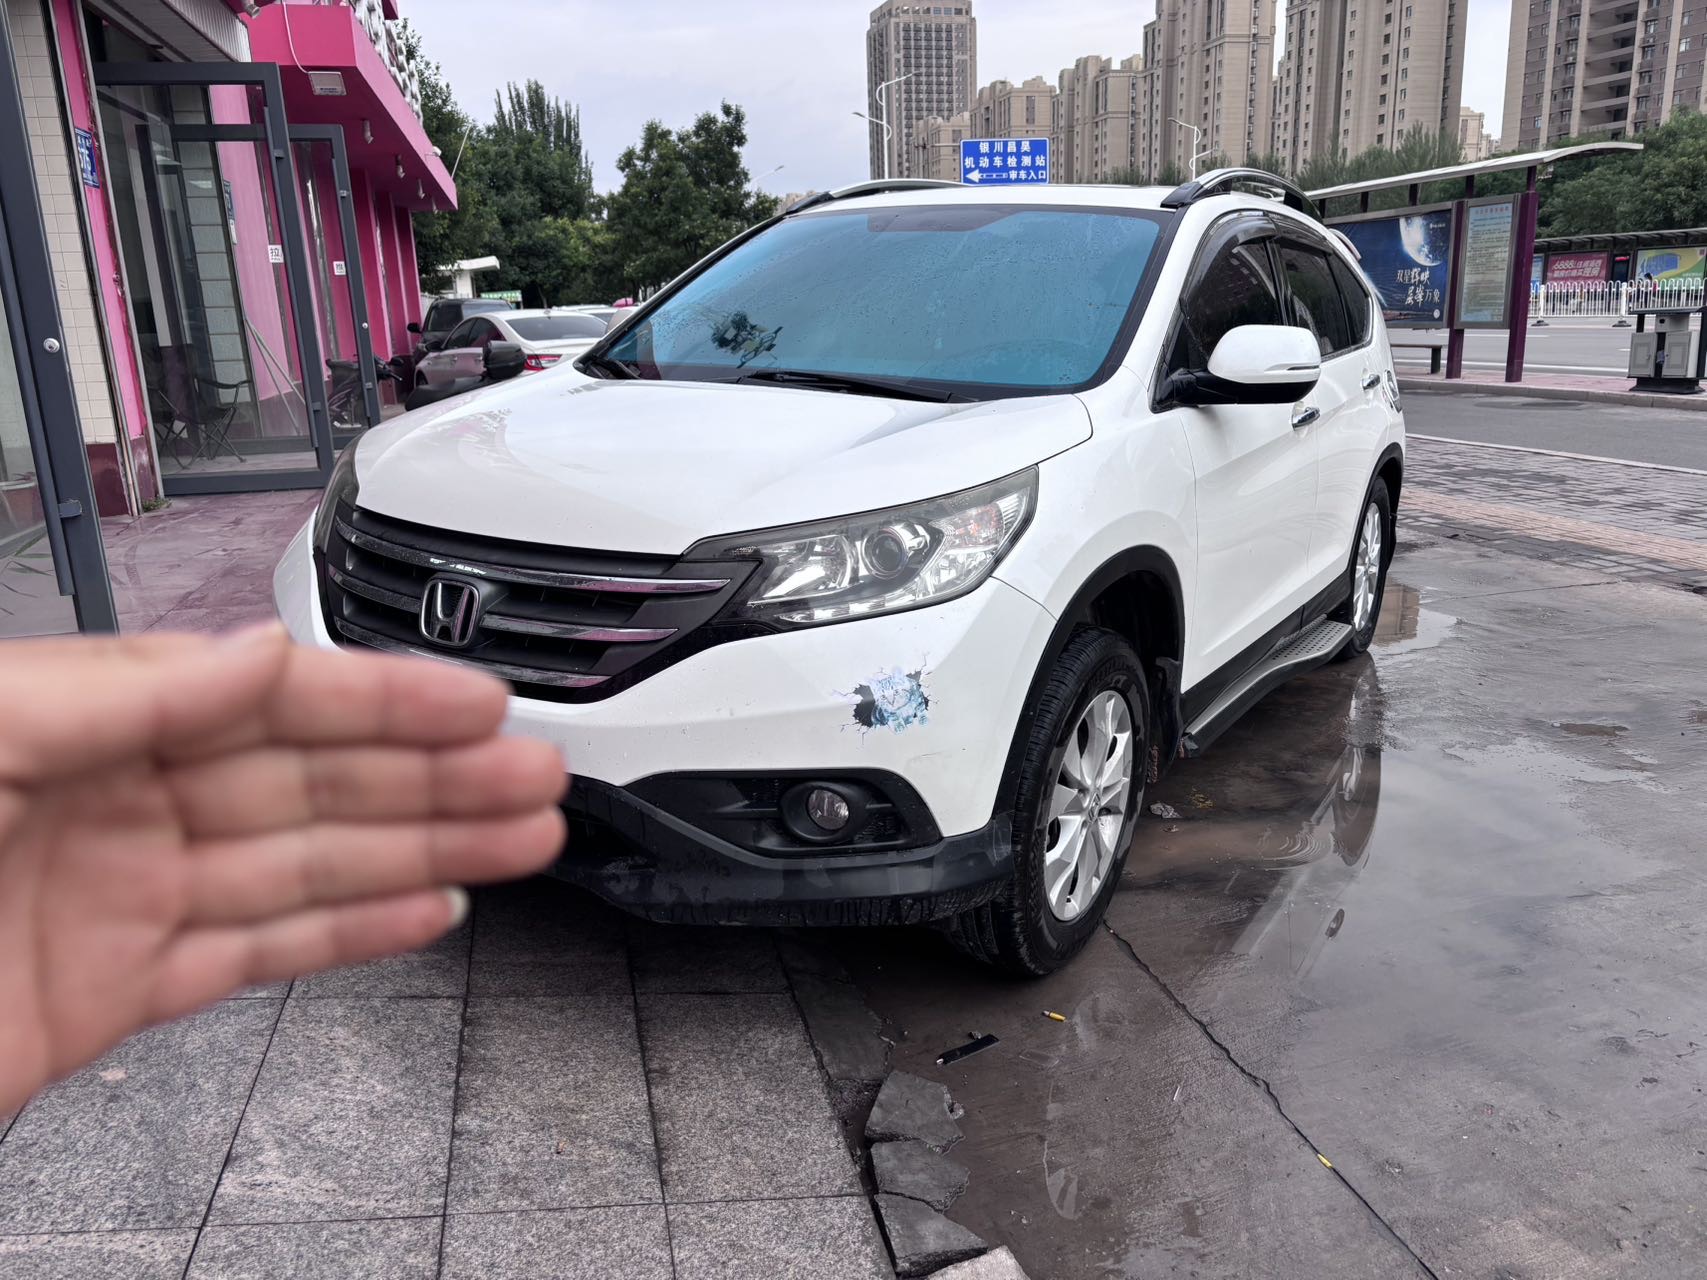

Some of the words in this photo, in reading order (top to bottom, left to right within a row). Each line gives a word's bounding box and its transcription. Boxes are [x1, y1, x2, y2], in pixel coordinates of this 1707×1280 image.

[964, 155, 1046, 168] 机动车检测站
[1009, 170, 1046, 180] 审车入口
